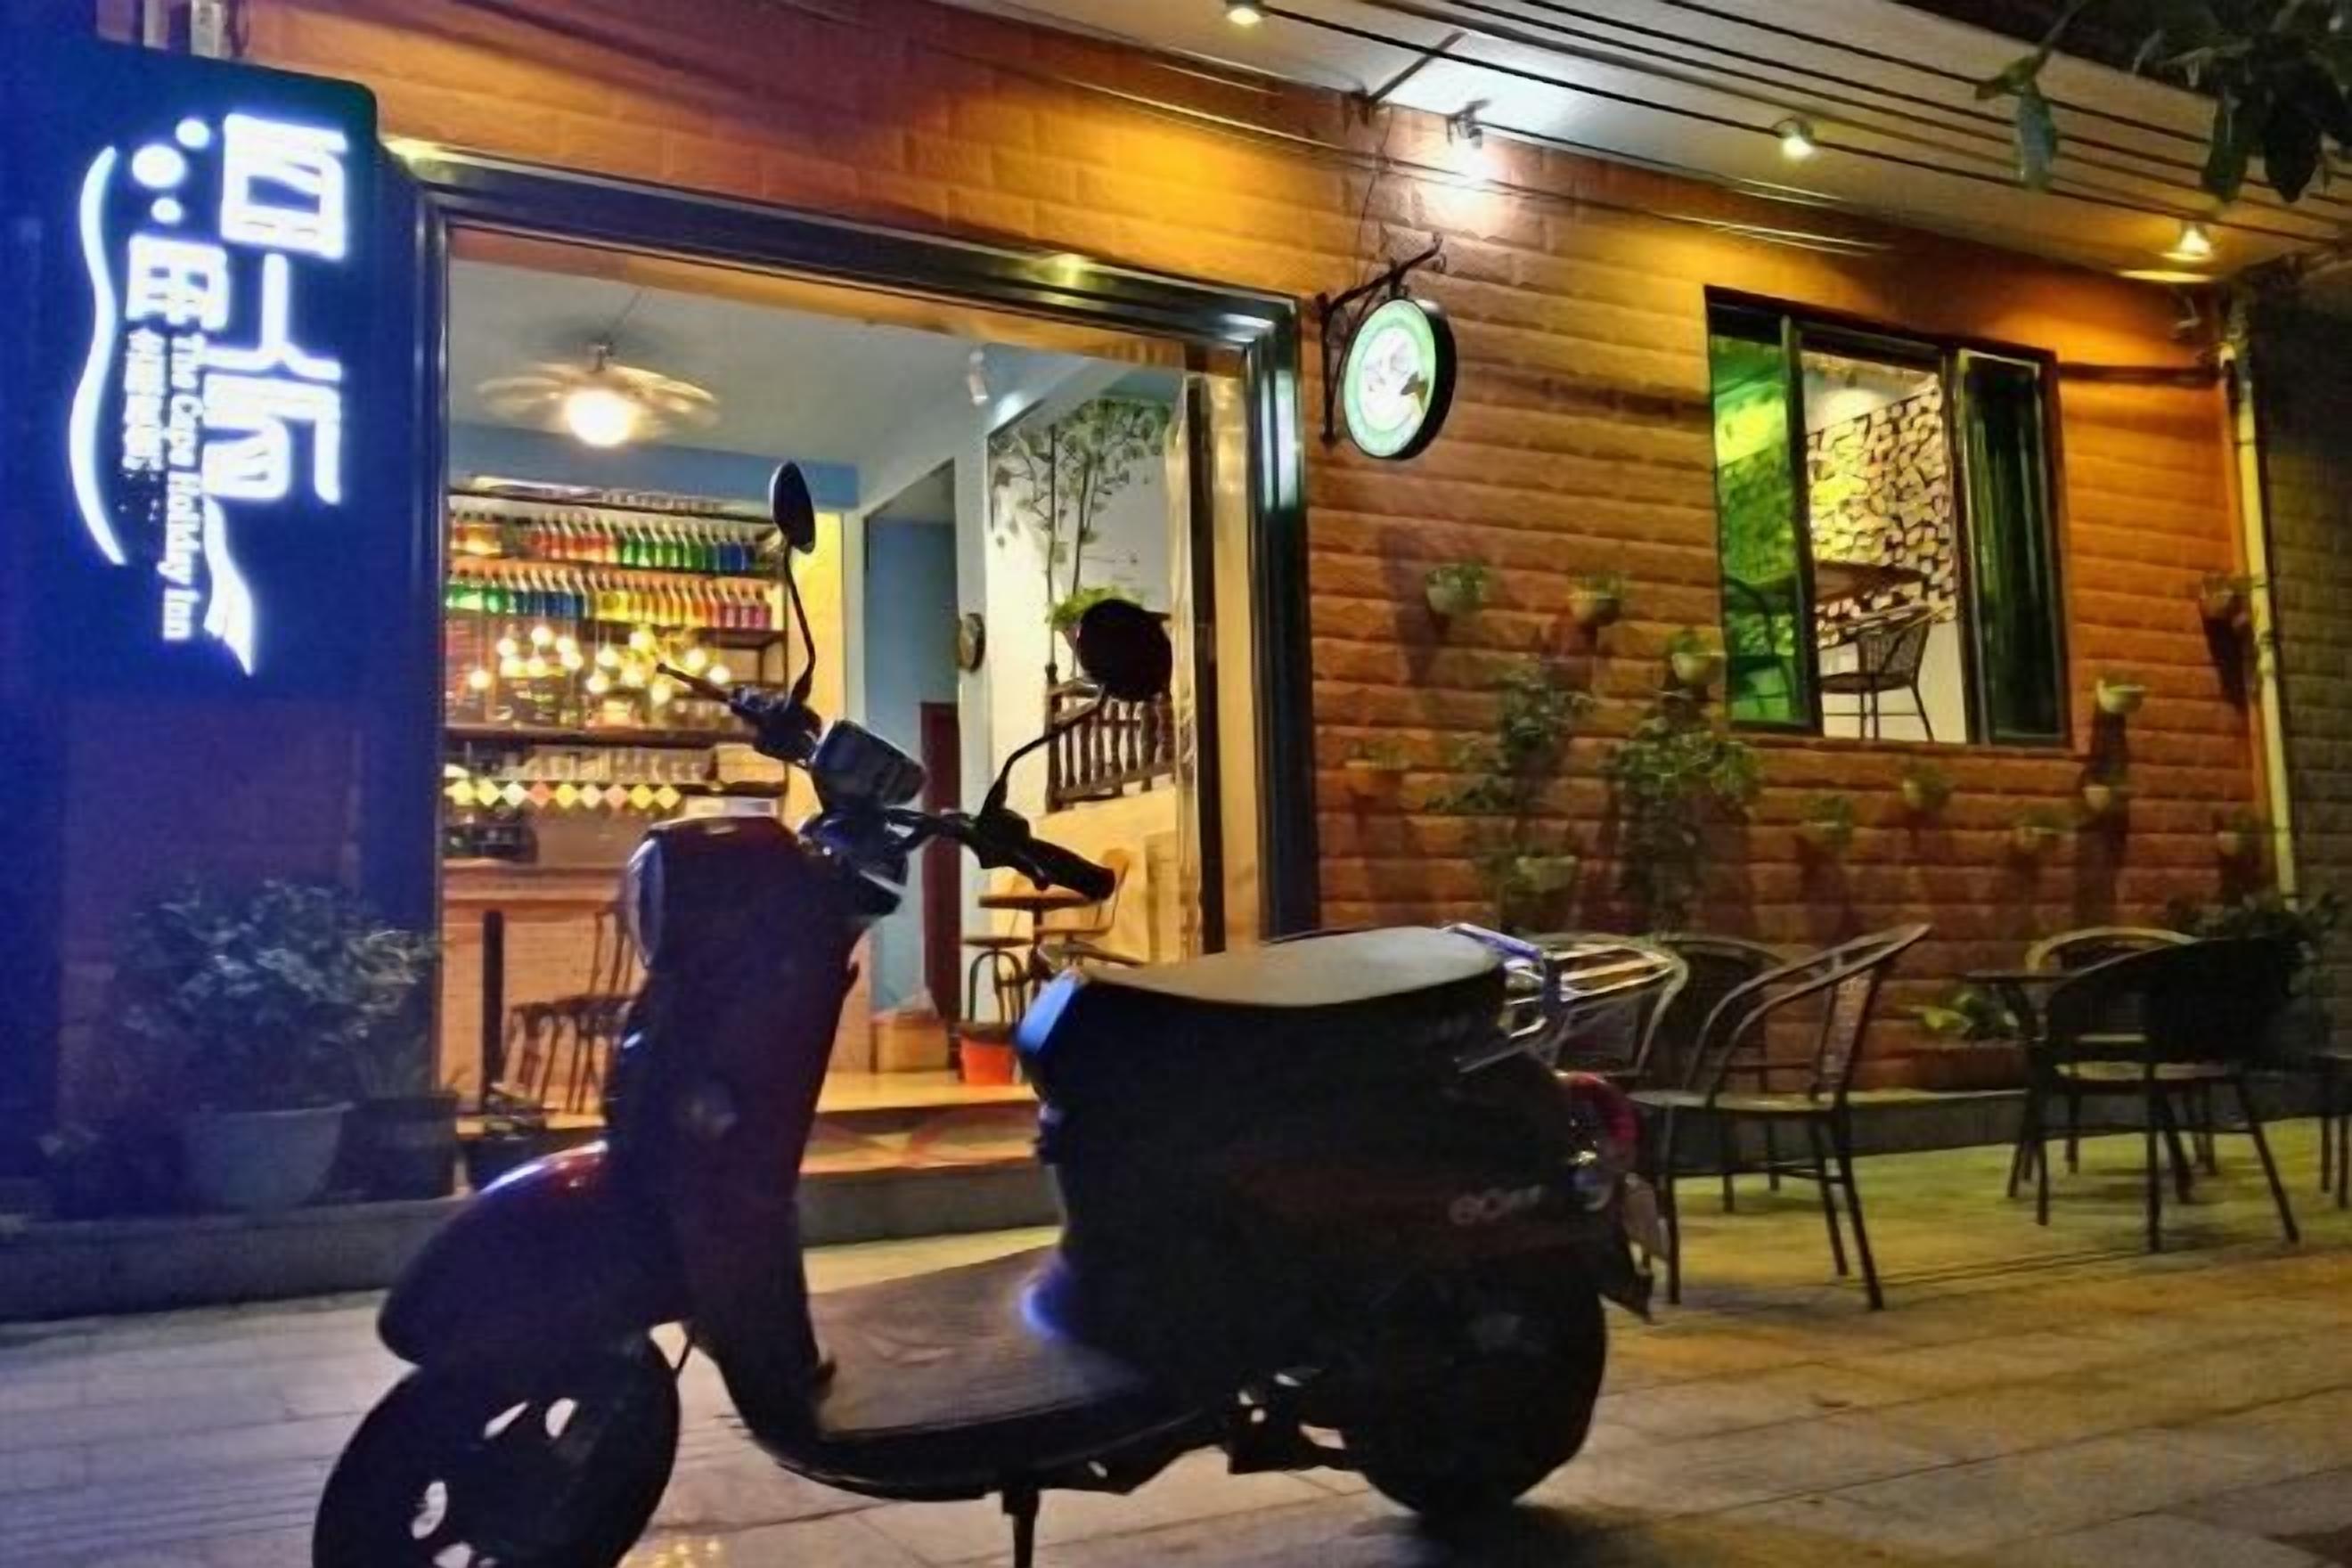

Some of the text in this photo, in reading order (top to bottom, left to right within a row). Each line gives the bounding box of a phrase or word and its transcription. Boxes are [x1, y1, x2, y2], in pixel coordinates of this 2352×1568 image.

[171, 334, 205, 389] The
[158, 470, 201, 585] Holiday
[164, 589, 200, 639] Inn
